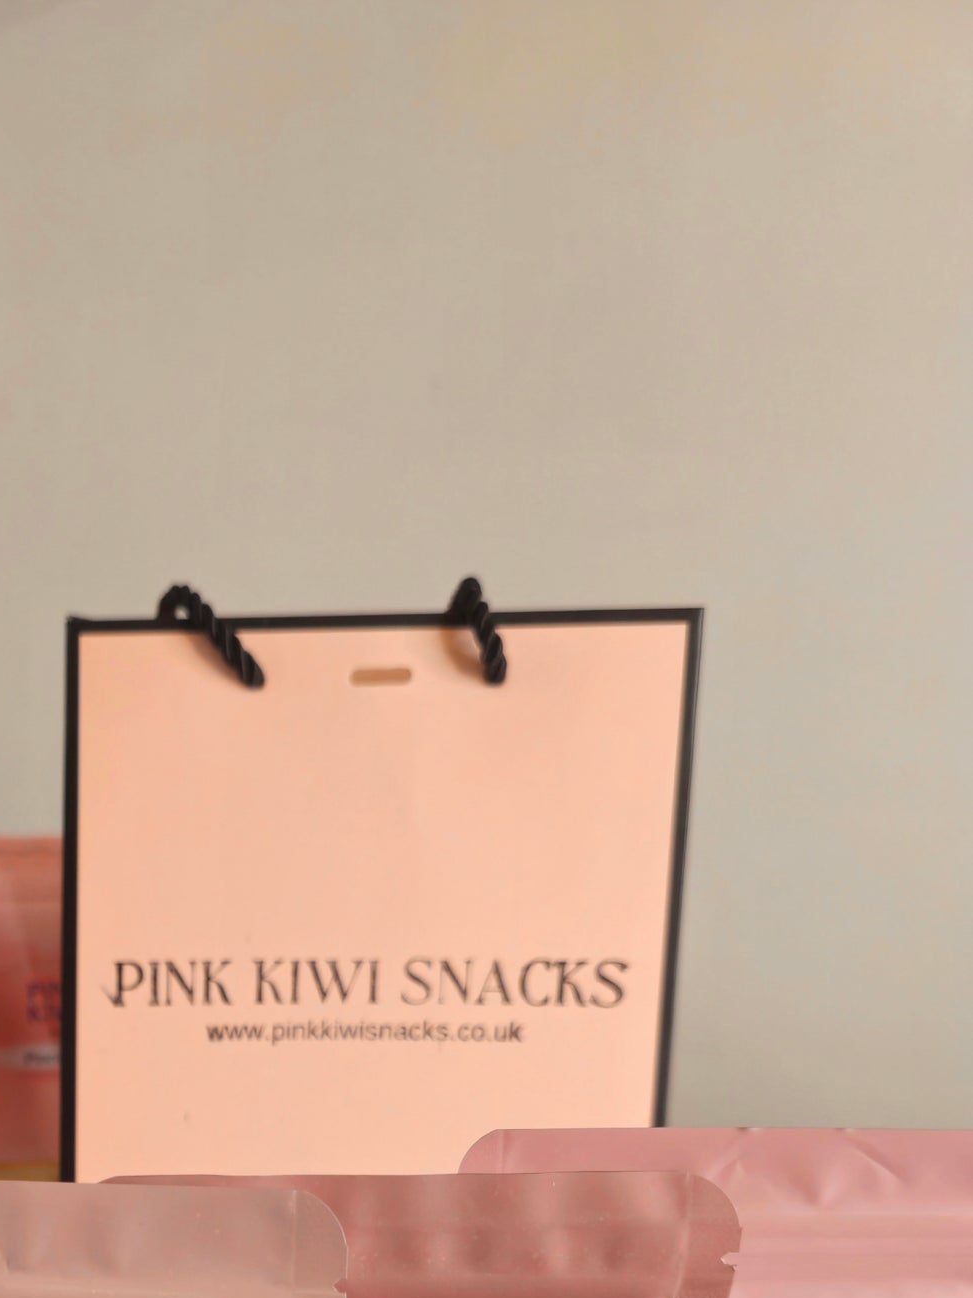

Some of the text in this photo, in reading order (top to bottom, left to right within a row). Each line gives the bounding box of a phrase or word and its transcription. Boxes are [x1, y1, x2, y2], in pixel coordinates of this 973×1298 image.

[105, 959, 233, 1008] PINK
[252, 958, 380, 1006] KIWI
[399, 957, 630, 1008] SNACKS
[205, 1020, 523, 1045] www.pinkkiwisnacks.co.uk
